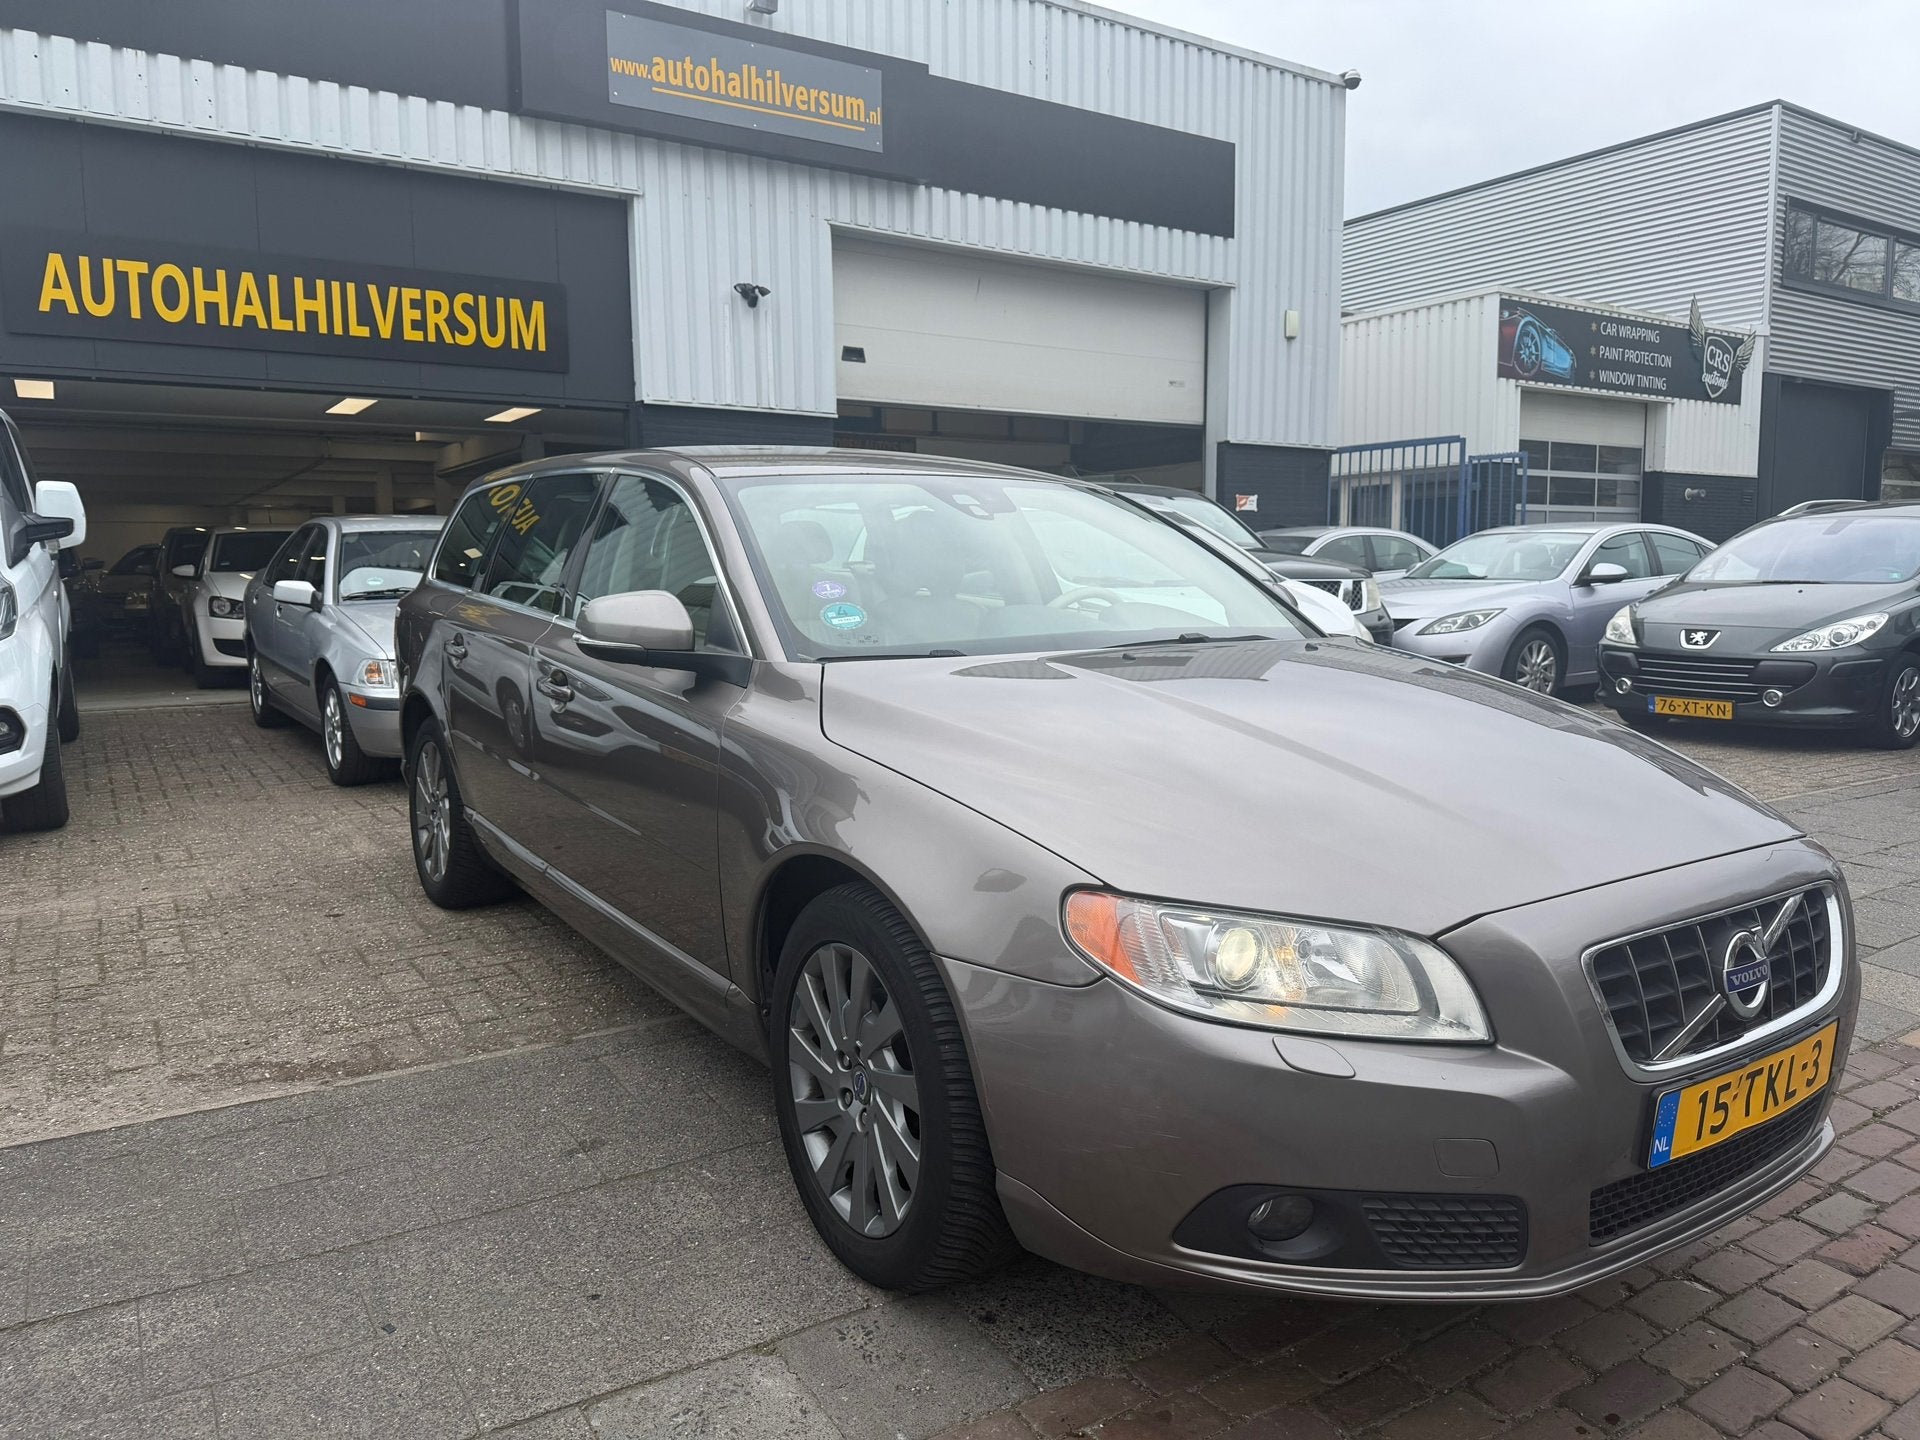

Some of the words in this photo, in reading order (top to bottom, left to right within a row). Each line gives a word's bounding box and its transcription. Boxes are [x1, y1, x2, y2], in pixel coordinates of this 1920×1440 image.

[610, 56, 881, 125] www.autohalhilversum.nl
[39, 252, 547, 352] AUTOHALHILVERSUM
[1600, 321, 1617, 338] CAR
[1618, 325, 1660, 344] WRAPPING
[1599, 345, 1623, 361] PAINT
[1624, 350, 1672, 369] PROTECTION
[1707, 345, 1730, 373] CRS
[1599, 369, 1635, 387] WINDOW
[1636, 374, 1667, 391] TINTING
[1659, 699, 1726, 717] 76-XT-KN
[1730, 964, 1768, 986] VOLVO
[1696, 1039, 1822, 1141] 15-TKL-3
[1653, 1135, 1669, 1154] NL
